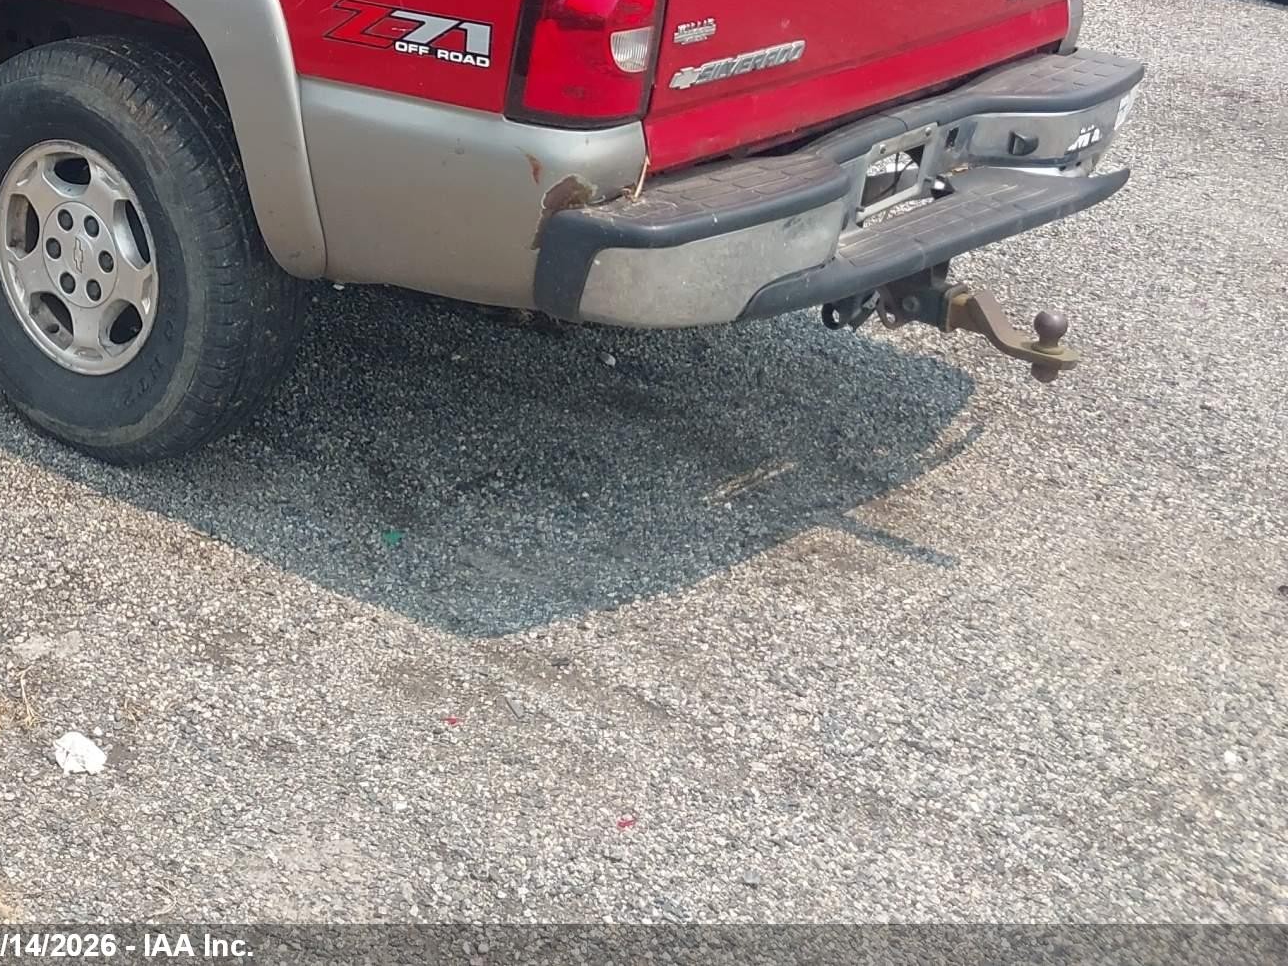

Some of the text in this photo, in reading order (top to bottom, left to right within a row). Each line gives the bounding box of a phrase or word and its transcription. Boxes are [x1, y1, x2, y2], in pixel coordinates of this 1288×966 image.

[395, 41, 490, 67] OFF ROAD
[696, 40, 805, 83] SILVERADO
